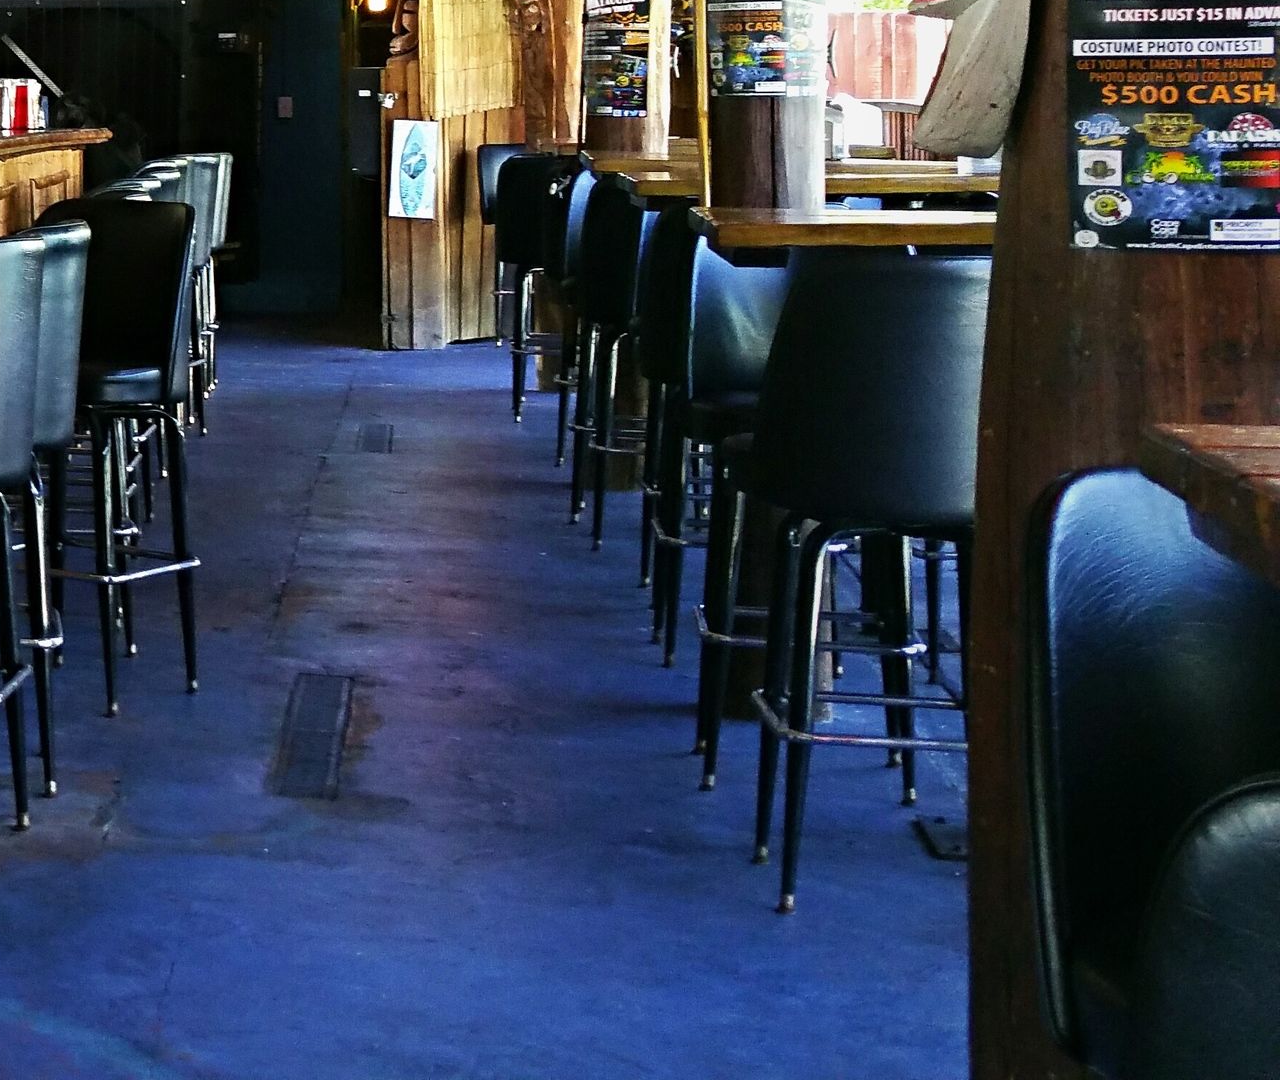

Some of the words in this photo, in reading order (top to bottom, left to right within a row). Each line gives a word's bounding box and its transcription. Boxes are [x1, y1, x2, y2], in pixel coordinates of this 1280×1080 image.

[1103, 9, 1158, 21] TICKETS
[1160, 8, 1192, 21] JUST
[1197, 7, 1224, 21] $15
[1226, 7, 1241, 20] IN
[744, 21, 785, 32] CASH
[1080, 41, 1143, 54] COSTUME
[1147, 41, 1194, 53] PHOTO
[1197, 39, 1263, 52] CONTEST!
[1077, 60, 1096, 70] GET
[1099, 59, 1127, 69] YOUR
[1149, 58, 1184, 69] TAKEN
[1187, 58, 1200, 68] AT
[1201, 58, 1221, 68] THE
[1223, 57, 1276, 68] HAUNTED
[1090, 73, 1124, 83] PHOTO
[1127, 72, 1165, 82] BOOTH
[1176, 72, 1199, 82] YOU
[1201, 72, 1238, 82] COULD
[1240, 71, 1263, 81] WIN
[1101, 83, 1179, 106] $500
[1186, 83, 1277, 104] CASH
